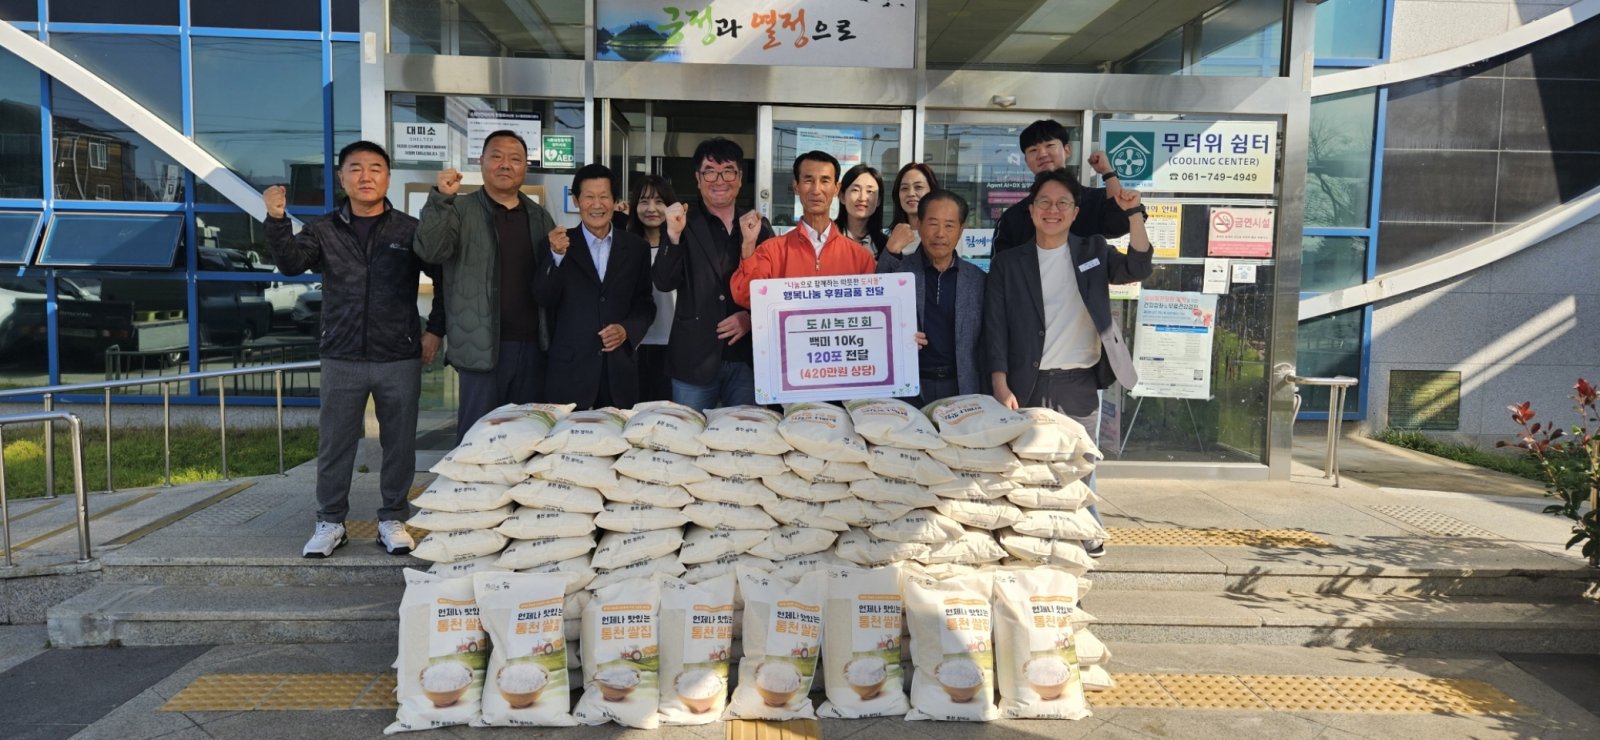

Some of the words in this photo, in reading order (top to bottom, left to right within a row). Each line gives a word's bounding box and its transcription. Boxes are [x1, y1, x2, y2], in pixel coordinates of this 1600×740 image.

[657, 6, 743, 45] 긍정과
[751, 8, 857, 50] 열정으로
[406, 126, 436, 136] 대피소
[1161, 133, 1223, 153] 무더위
[1231, 134, 1269, 154] 쉼터
[556, 154, 574, 162] AED
[1168, 157, 1216, 166] (COOLING
[1218, 157, 1260, 167] CENTER)
[1181, 173, 1258, 182] 061-749-4949
[1234, 218, 1270, 228] 금연시설
[814, 279, 839, 288] 함께하는
[840, 278, 859, 286] 따뜻한
[783, 290, 821, 300] 행복나눔
[824, 288, 862, 298] 후원금품
[865, 286, 884, 296] 전달
[809, 336, 831, 347] 백미
[834, 335, 864, 347] 10Kg
[807, 351, 842, 363] 120포
[846, 349, 869, 361] 전달
[800, 367, 848, 379] (420만원
[851, 365, 876, 377] 상당)
[438, 608, 463, 617] 언제나
[859, 604, 882, 614] 언제나
[883, 604, 901, 614] 맛있는
[945, 608, 967, 616] 언제나
[1032, 605, 1055, 613] 언제나
[518, 612, 541, 621] 언제나
[601, 616, 625, 625] 언제나
[627, 614, 651, 624] 맛있는
[692, 615, 716, 624] 언제나
[777, 611, 800, 620] 언제나
[800, 613, 820, 624] 맛있는
[627, 625, 652, 639] 쌀집
[801, 624, 818, 638] 쌀집
